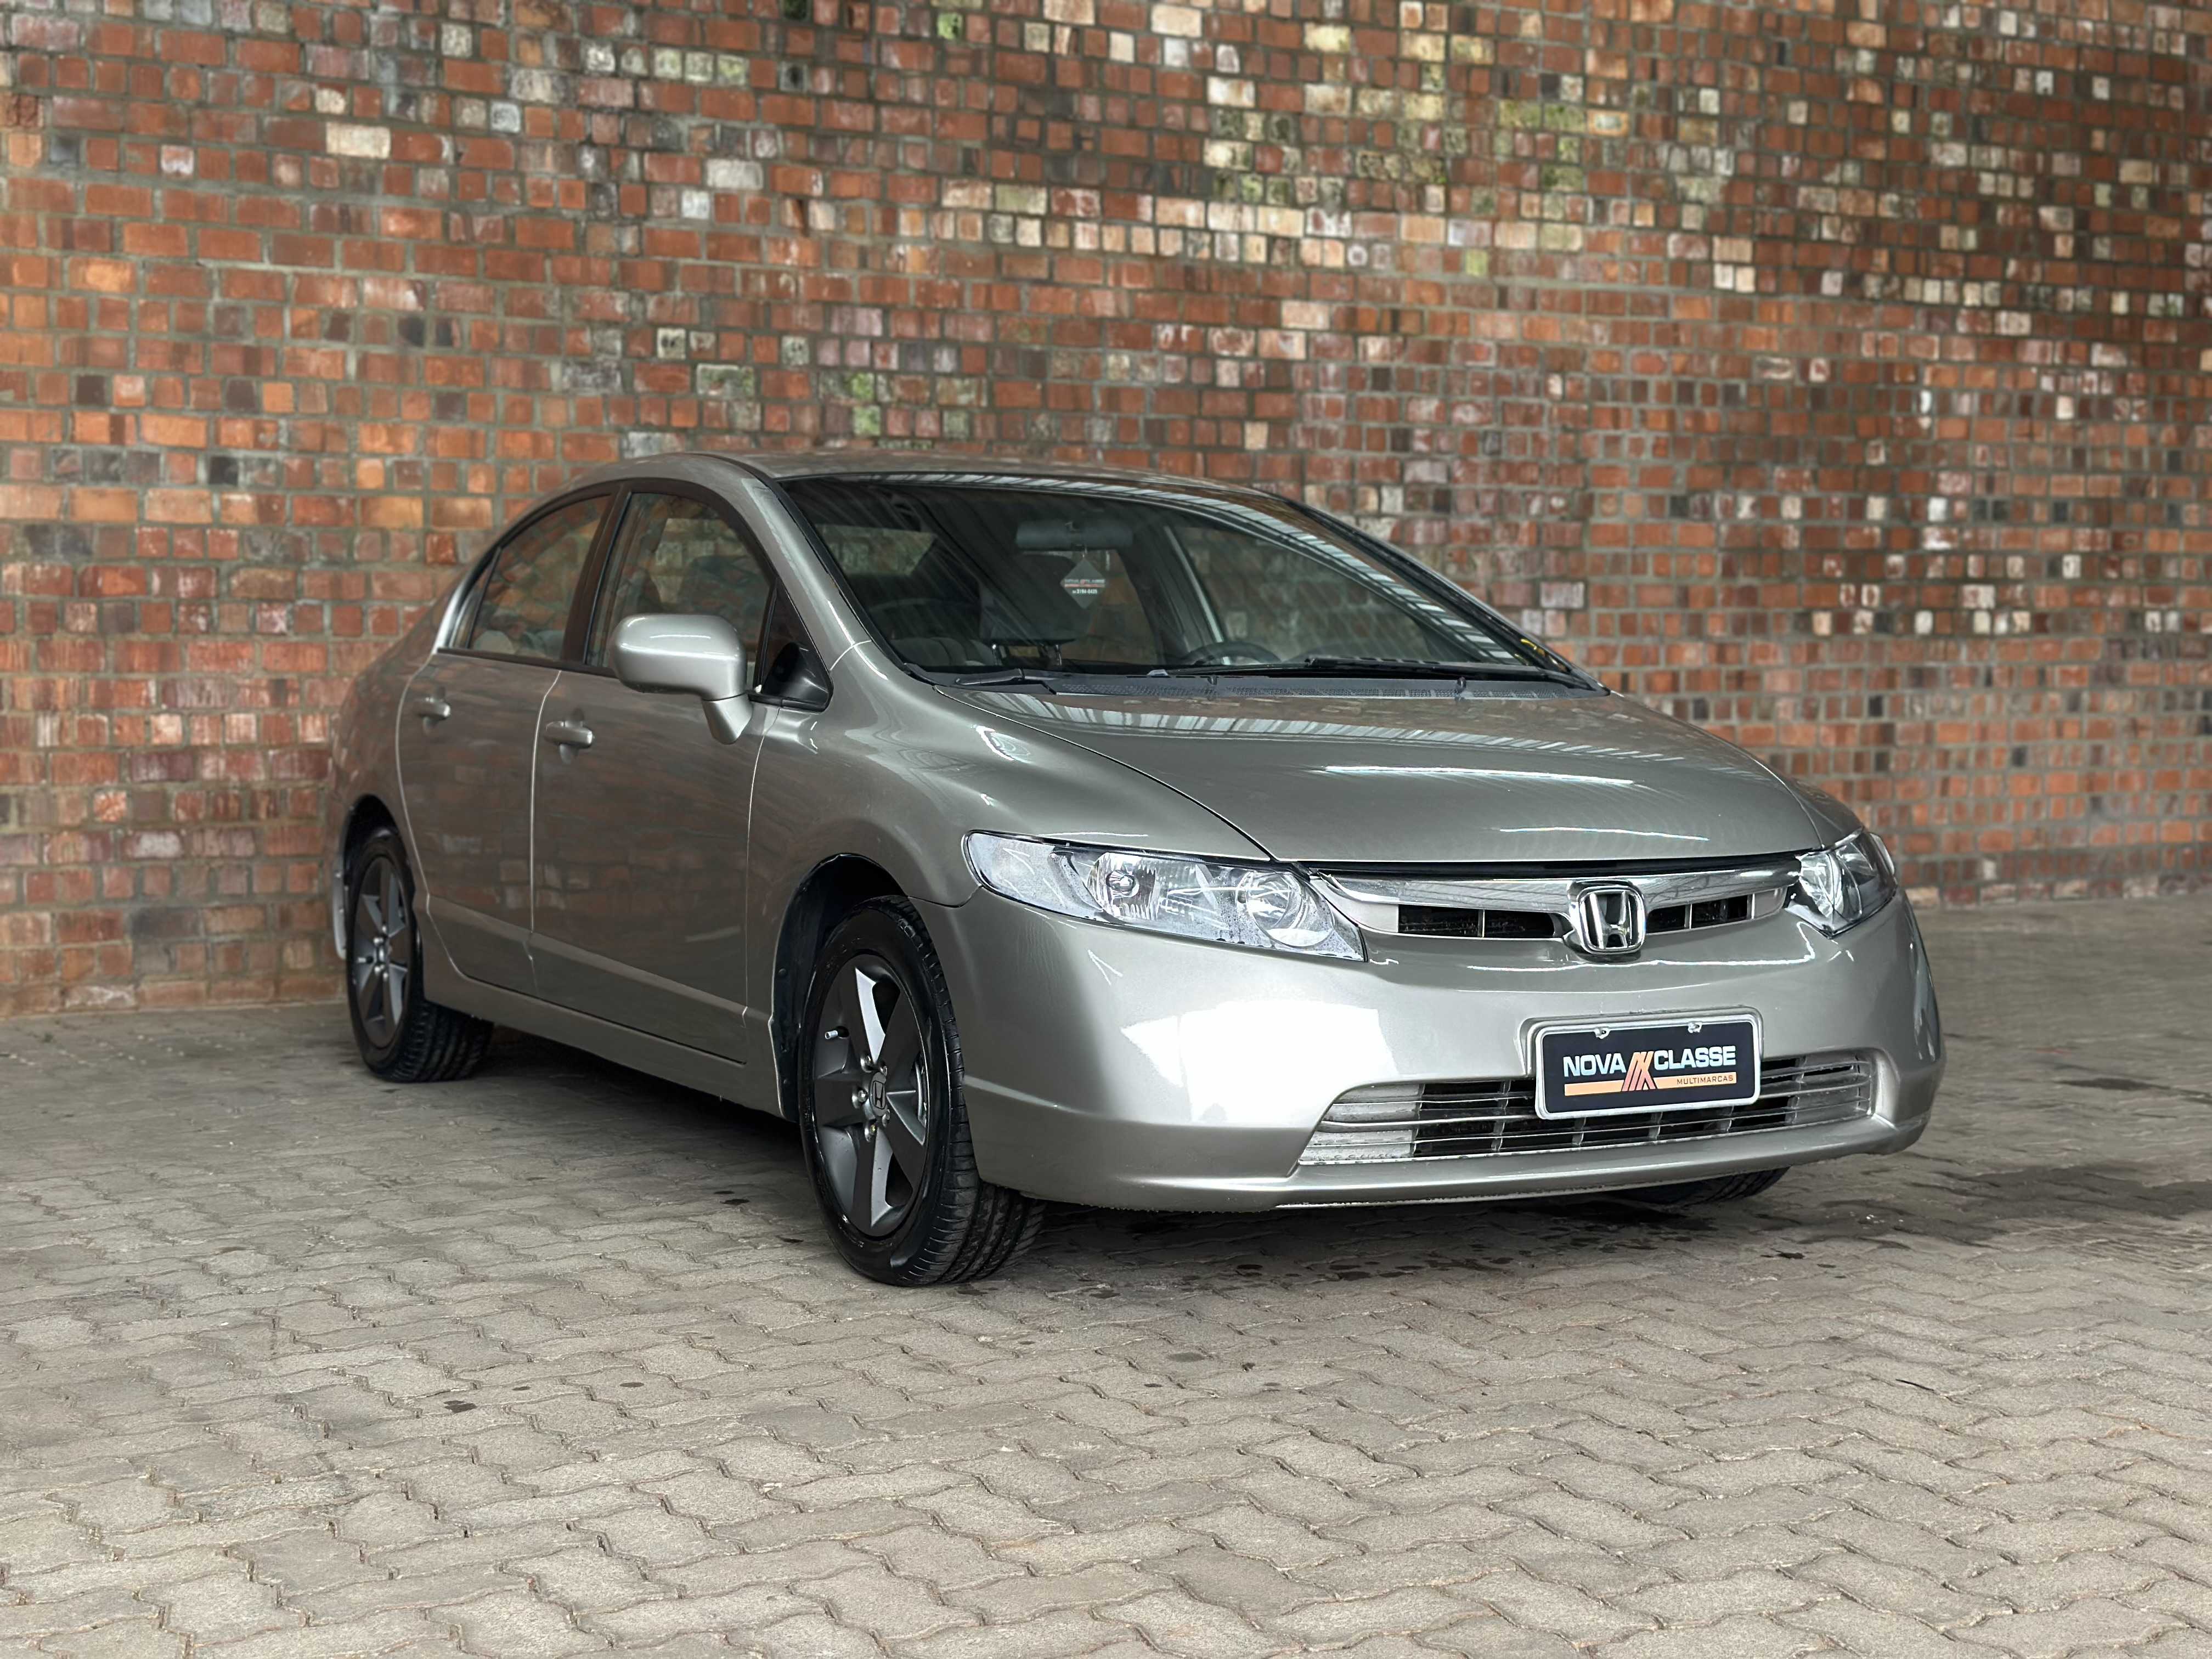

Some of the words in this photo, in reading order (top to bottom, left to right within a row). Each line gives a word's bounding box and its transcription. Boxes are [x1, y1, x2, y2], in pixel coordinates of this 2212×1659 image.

[1564, 1053, 1627, 1077] NOVA
[1654, 1045, 1736, 1070] CLASSE
[1677, 1075, 1734, 1085] MULTIMARCAS
